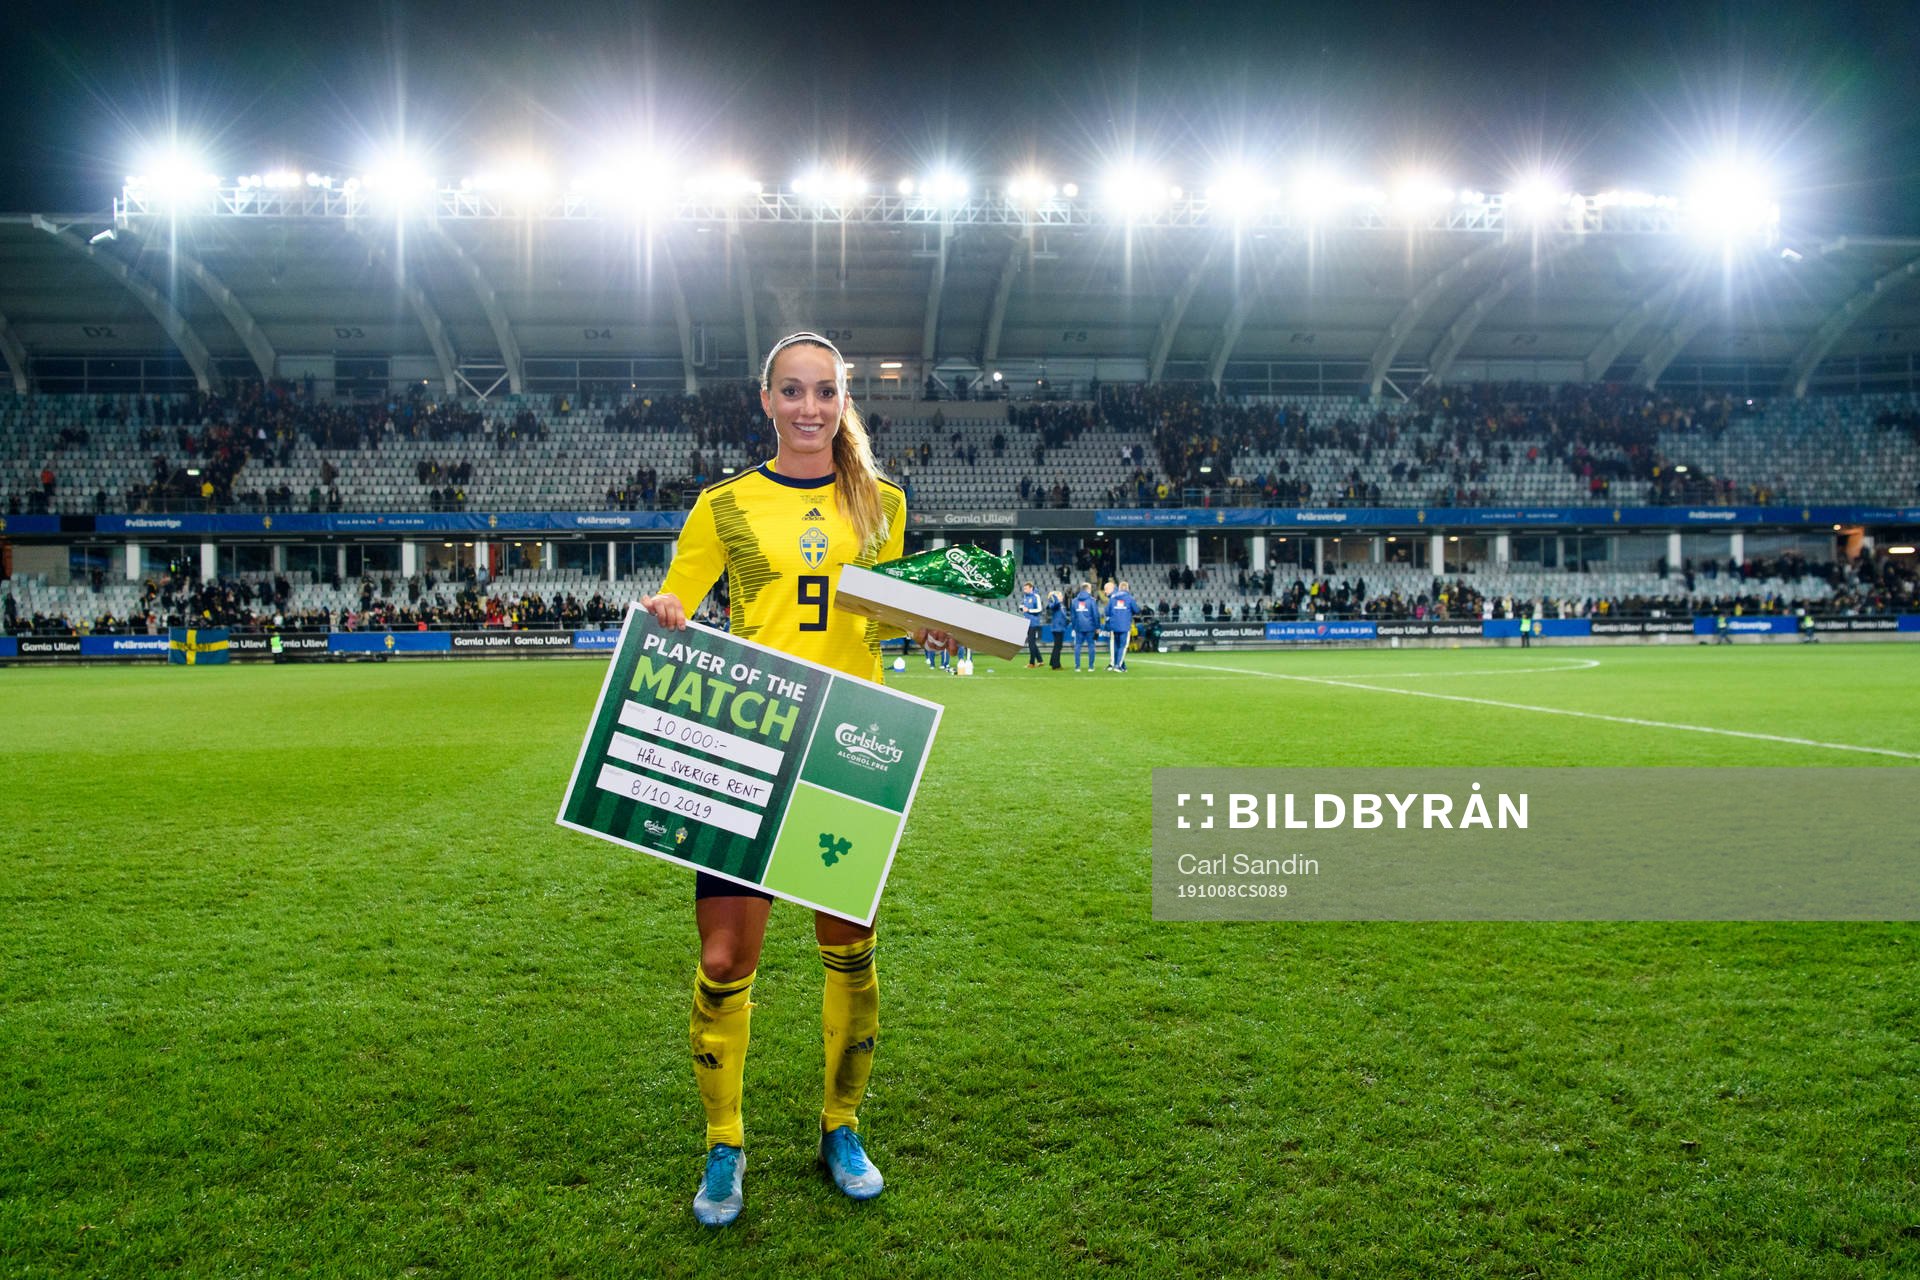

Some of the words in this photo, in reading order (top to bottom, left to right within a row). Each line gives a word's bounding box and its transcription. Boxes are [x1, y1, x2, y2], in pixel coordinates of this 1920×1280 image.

[82, 326, 116, 339] D2
[335, 328, 365, 340] D3
[584, 329, 613, 340] D4
[825, 329, 852, 341] D5
[944, 513, 981, 524] Gamla
[983, 513, 1014, 524] Ullevi
[798, 575, 830, 631] 9
[1185, 629, 1208, 637] Ullevi
[1212, 628, 1240, 637] Gamla
[1241, 628, 1264, 637] Ullevi
[1378, 626, 1403, 635] Gamla
[1405, 626, 1428, 635] Ullevi
[1432, 625, 1458, 634] Gamla
[1460, 625, 1482, 634] Ullevi
[22, 642, 52, 651] Gamla
[54, 641, 80, 651] Ullevi
[240, 640, 266, 649] Ullevi
[302, 639, 328, 648] Ullevi
[454, 637, 483, 646] Gamla
[485, 636, 510, 646] Ullevi
[514, 636, 543, 645] Gamla
[545, 636, 571, 645] Ullevi
[643, 633, 726, 675] PLAYER
[730, 664, 762, 685] OF
[767, 674, 807, 702] THE
[629, 655, 800, 743] MATCH
[653, 716, 676, 736] 10
[835, 722, 904, 763] Carlsberg
[837, 750, 870, 766] ALCOHOL
[871, 762, 889, 773] FREE
[637, 748, 665, 769] HÅLL
[671, 760, 720, 786] SVERIGE
[726, 778, 765, 799] RENT
[631, 780, 671, 805] 8/10
[674, 796, 712, 818] 2019
